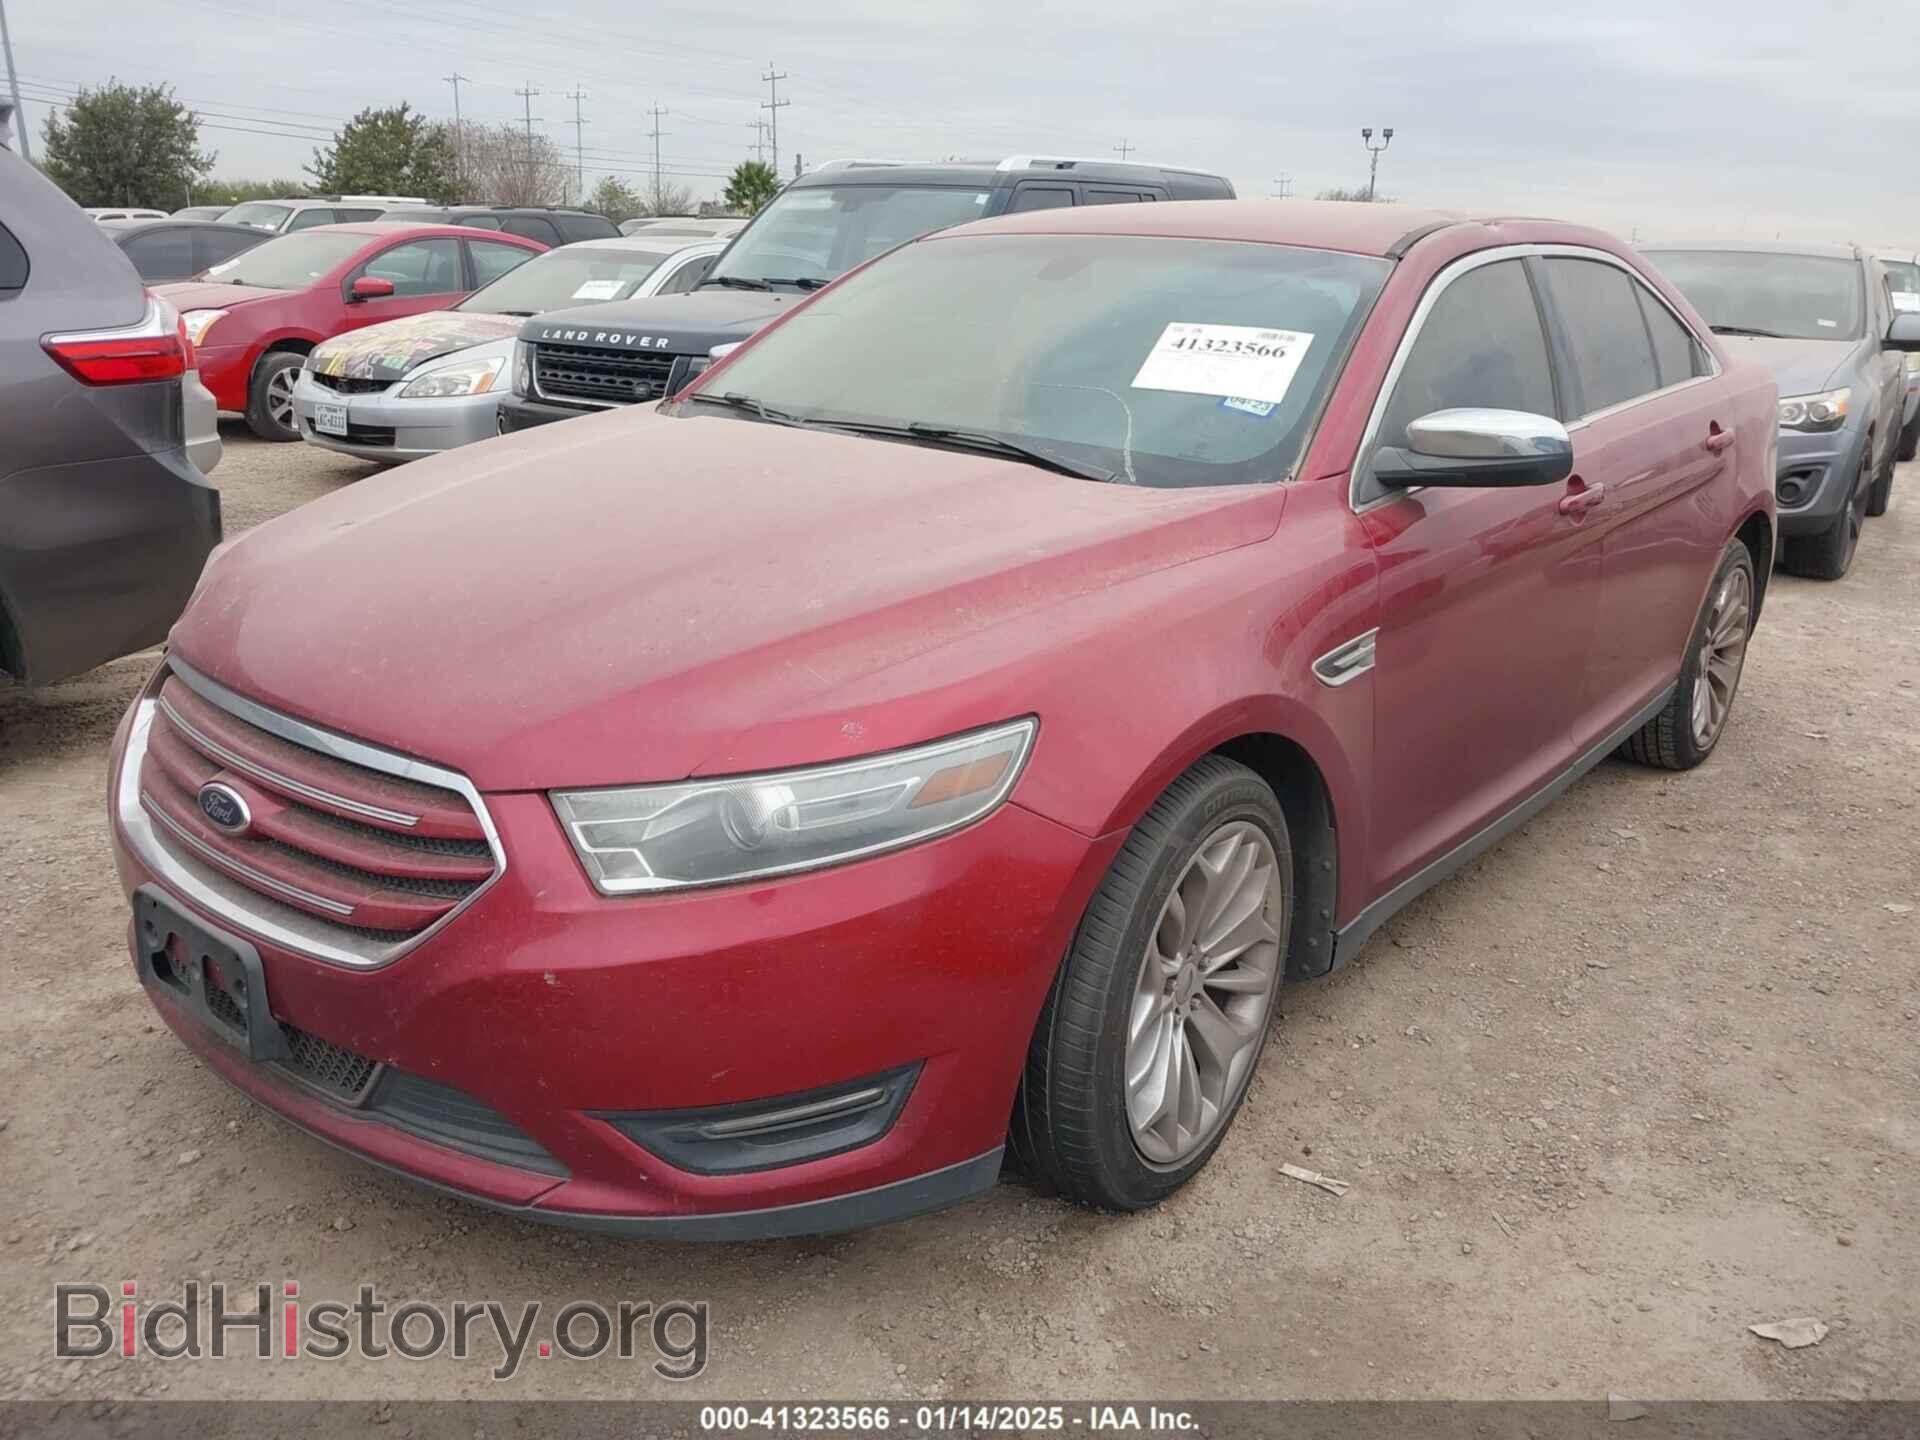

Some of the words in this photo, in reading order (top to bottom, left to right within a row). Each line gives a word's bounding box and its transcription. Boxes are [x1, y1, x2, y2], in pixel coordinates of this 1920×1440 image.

[541, 329, 588, 341] LAND
[595, 332, 670, 348] ROVER
[1171, 337, 1287, 358] 41323566
[207, 792, 234, 822] Ford
